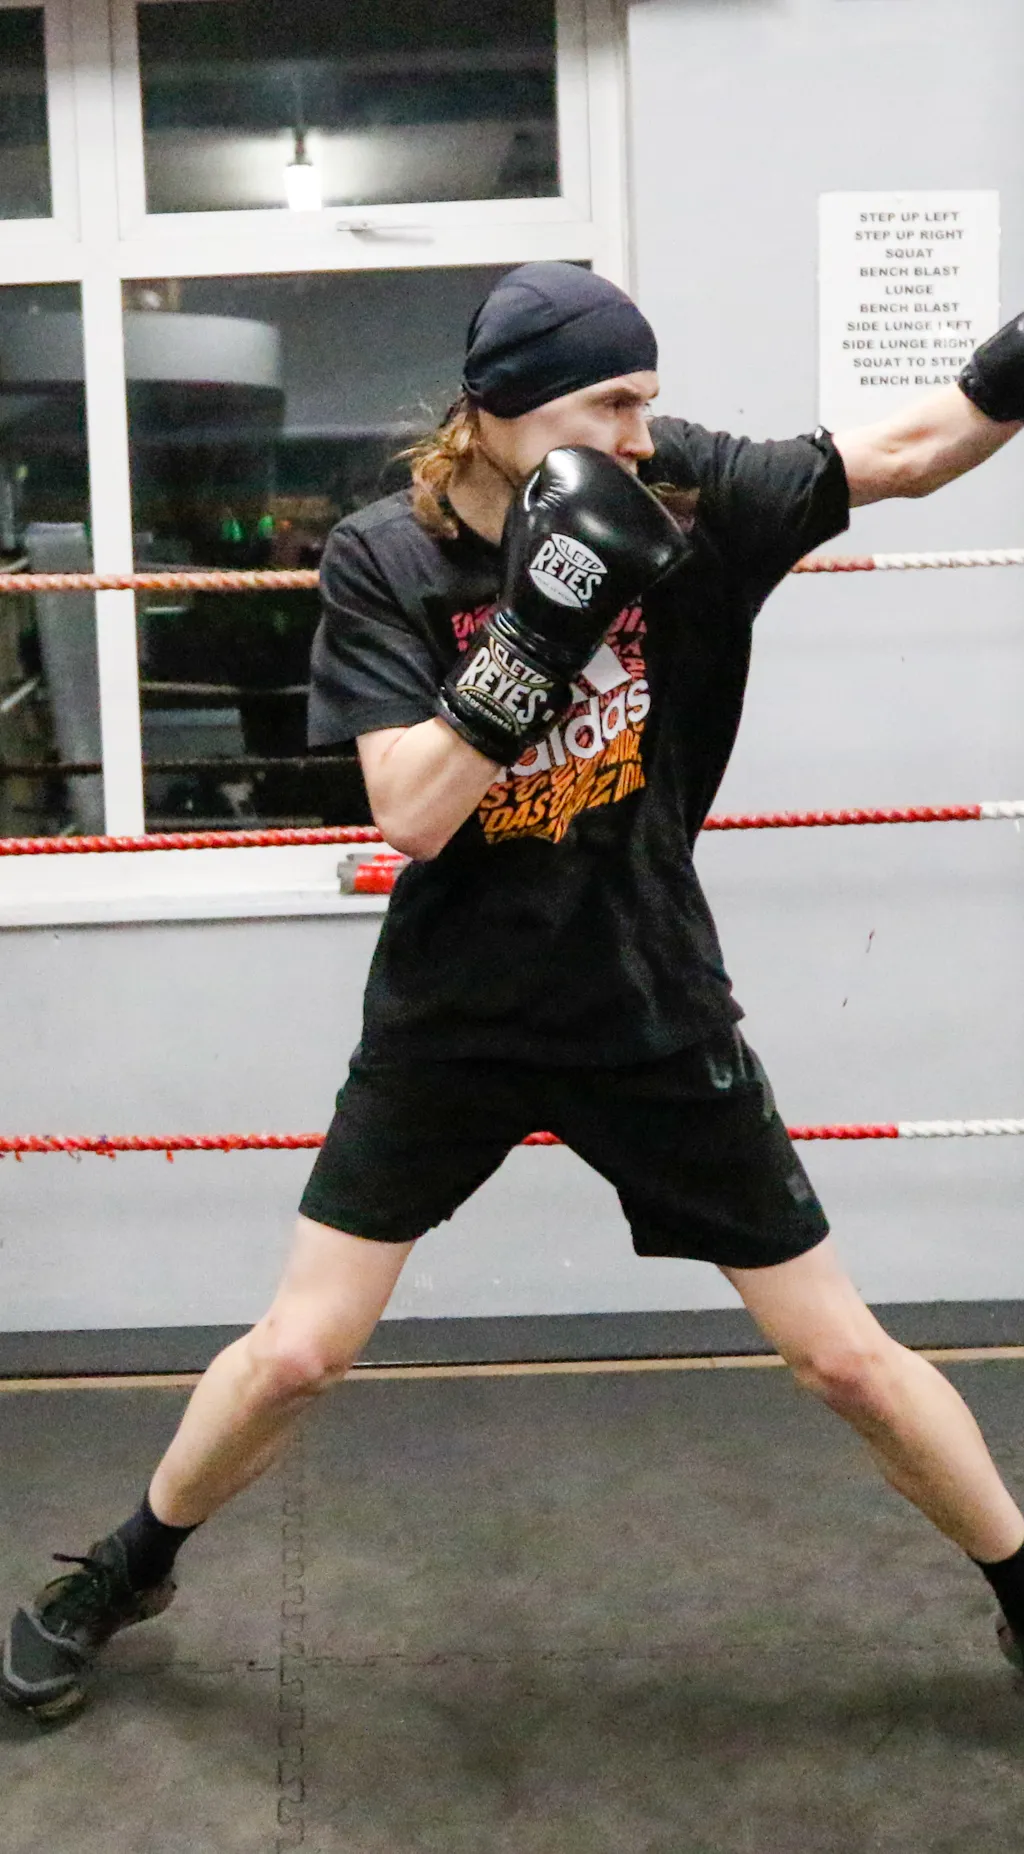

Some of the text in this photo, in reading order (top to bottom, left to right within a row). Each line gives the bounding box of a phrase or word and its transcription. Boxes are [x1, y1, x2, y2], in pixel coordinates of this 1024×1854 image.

[859, 211, 959, 222] STEP UP LEFT
[855, 230, 963, 241] STEP UP RIGHT
[885, 248, 934, 259] SQUAT
[859, 266, 959, 277] BENCH BLAST
[885, 285, 933, 295] LUNGE
[859, 303, 959, 313] BENCH BLAST
[847, 322, 879, 332] SIDE
[885, 322, 932, 331] LUNGE
[842, 338, 977, 350] SIDE LUNGE RIGHT
[853, 358, 900, 368] SQUAT
[907, 357, 926, 367] TO
[860, 376, 910, 386] BENCH
[558, 538, 601, 570] CLETO
[529, 539, 603, 600] REYES
[494, 642, 549, 684] CLETO
[456, 646, 548, 725] REYES
